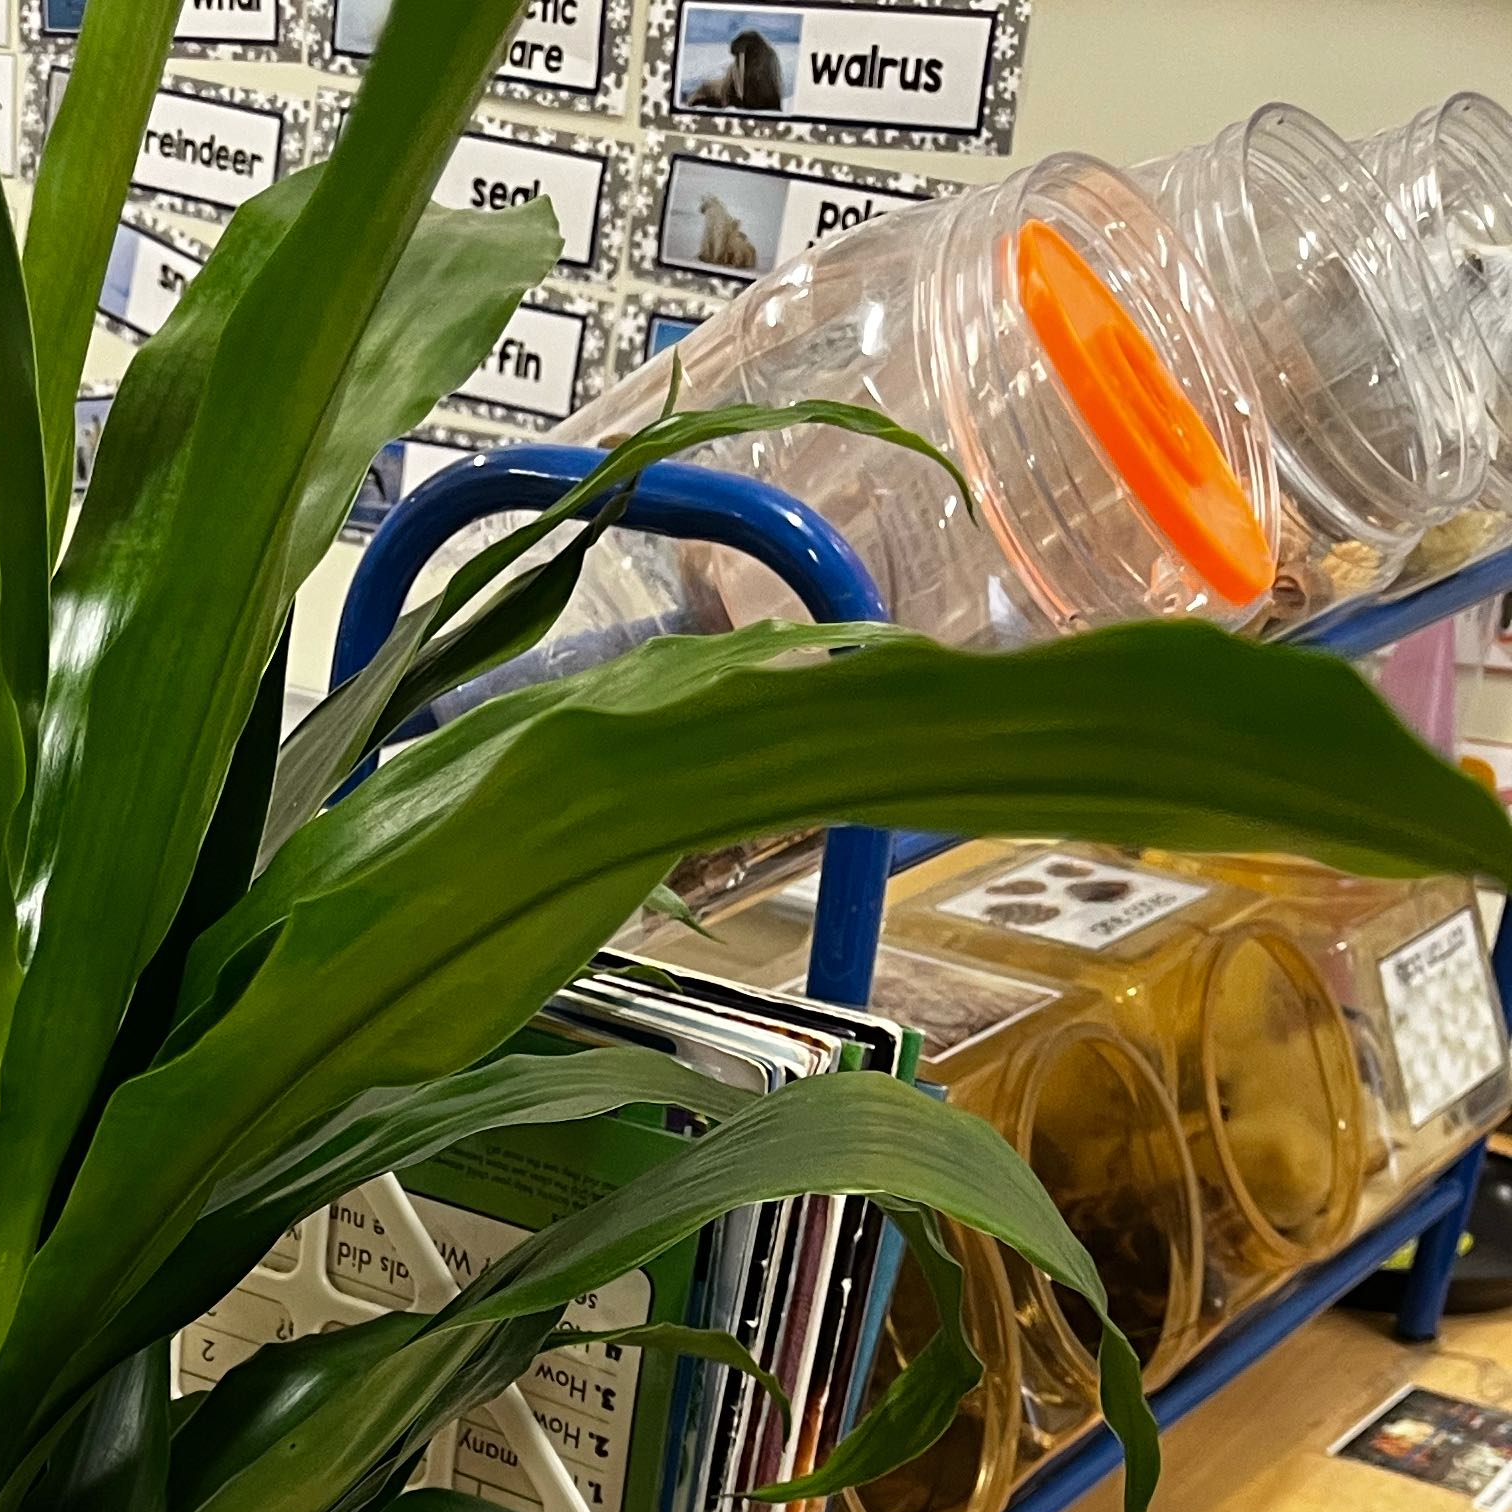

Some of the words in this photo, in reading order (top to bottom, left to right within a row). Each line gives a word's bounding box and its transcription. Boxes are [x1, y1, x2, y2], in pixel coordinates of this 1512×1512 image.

[509, 40, 564, 73] are
[810, 43, 944, 93] walrus
[144, 129, 264, 177] reindeer
[470, 177, 541, 210] seal
[816, 199, 888, 238] pol
[480, 337, 542, 382] fin
[337, 1241, 372, 1273] did
[201, 1338, 216, 1362] 2
[535, 1362, 588, 1403] How
[595, 1384, 617, 1412] 3.
[458, 1428, 519, 1468] many
[533, 1410, 581, 1448] How
[588, 1431, 610, 1458] 2.
[588, 1482, 604, 1504] 1.
